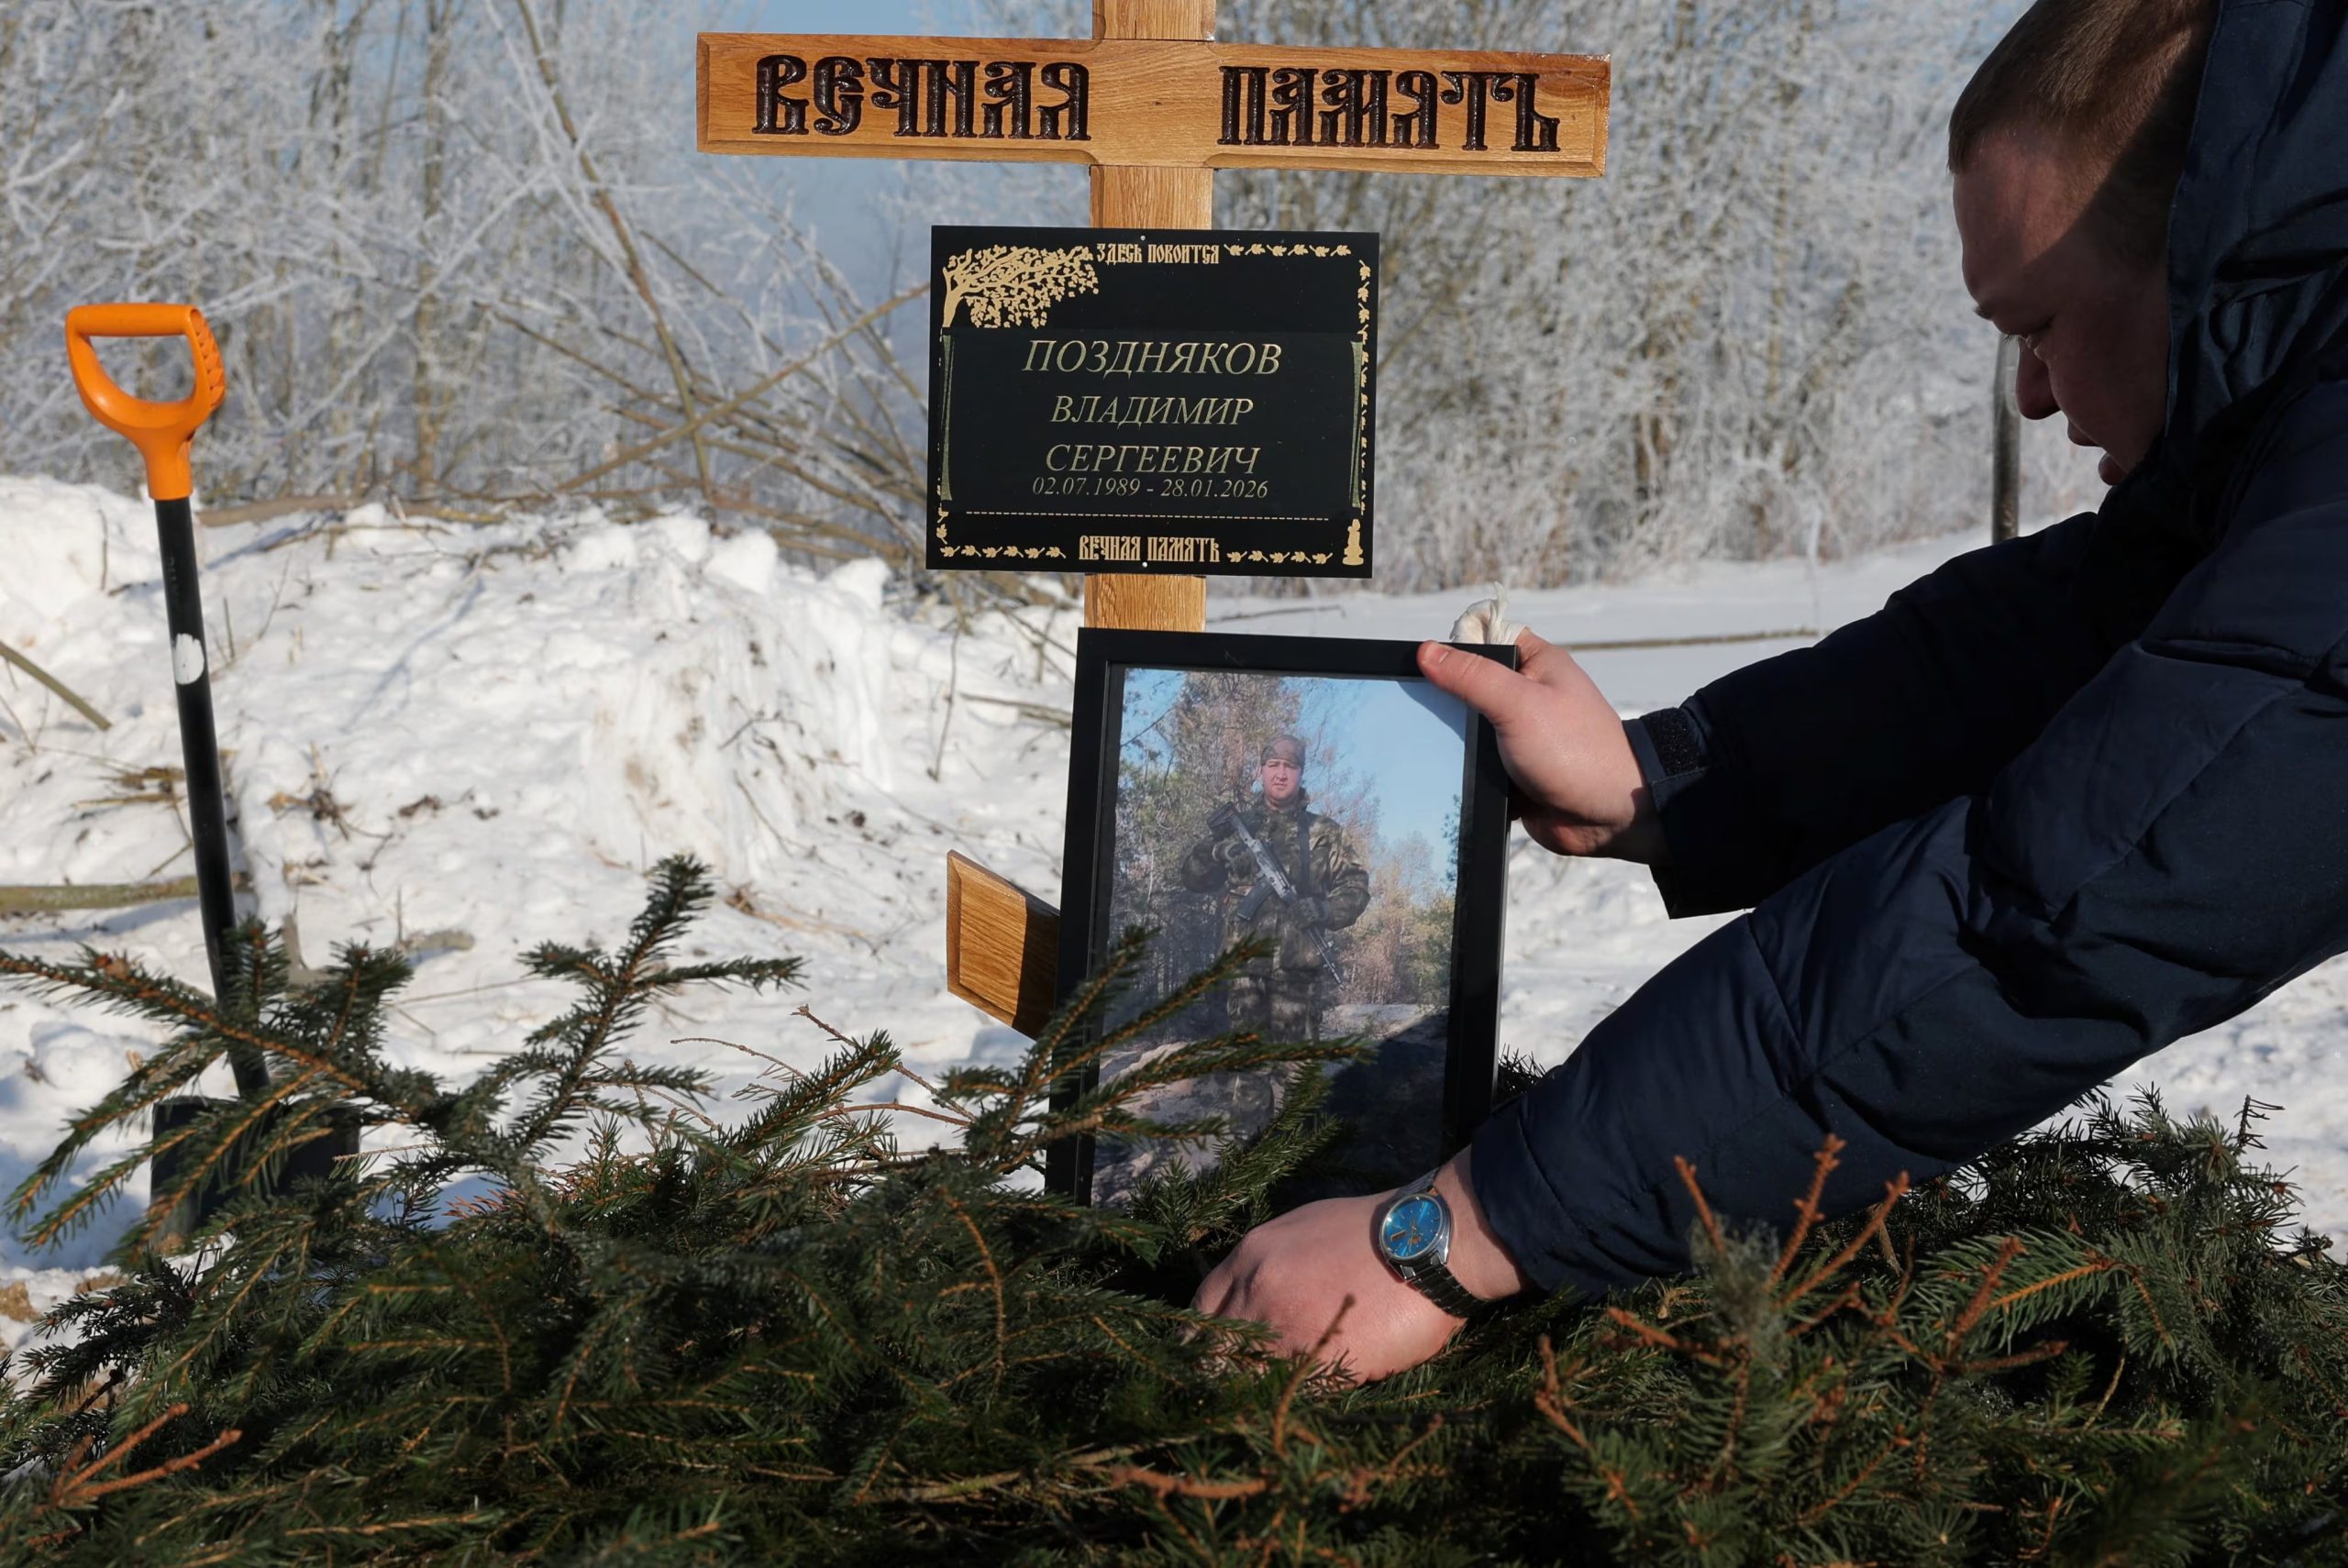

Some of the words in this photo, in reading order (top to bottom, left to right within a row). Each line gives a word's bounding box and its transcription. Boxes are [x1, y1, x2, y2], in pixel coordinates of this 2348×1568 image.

[752, 54, 1091, 141] ВЕЧНАЯ
[1217, 65, 1561, 152] ПАМЯТЬ
[1096, 243, 1143, 266] ЗДЕСЬ
[1147, 244, 1220, 264] ПОКОИТСЯ
[1021, 339, 1282, 379] ПОЗДНЯКОВ
[1050, 395, 1254, 430] ВЛАДИМИР
[1046, 444, 1261, 474] СЕРГЕЕВИЧ
[1032, 477, 1140, 496] 02.07.1989
[1161, 479, 1268, 498] 28.01.2026
[1079, 535, 1141, 561] ВЕЧНАЯ
[1146, 536, 1220, 563] ПАМЯТЬ
